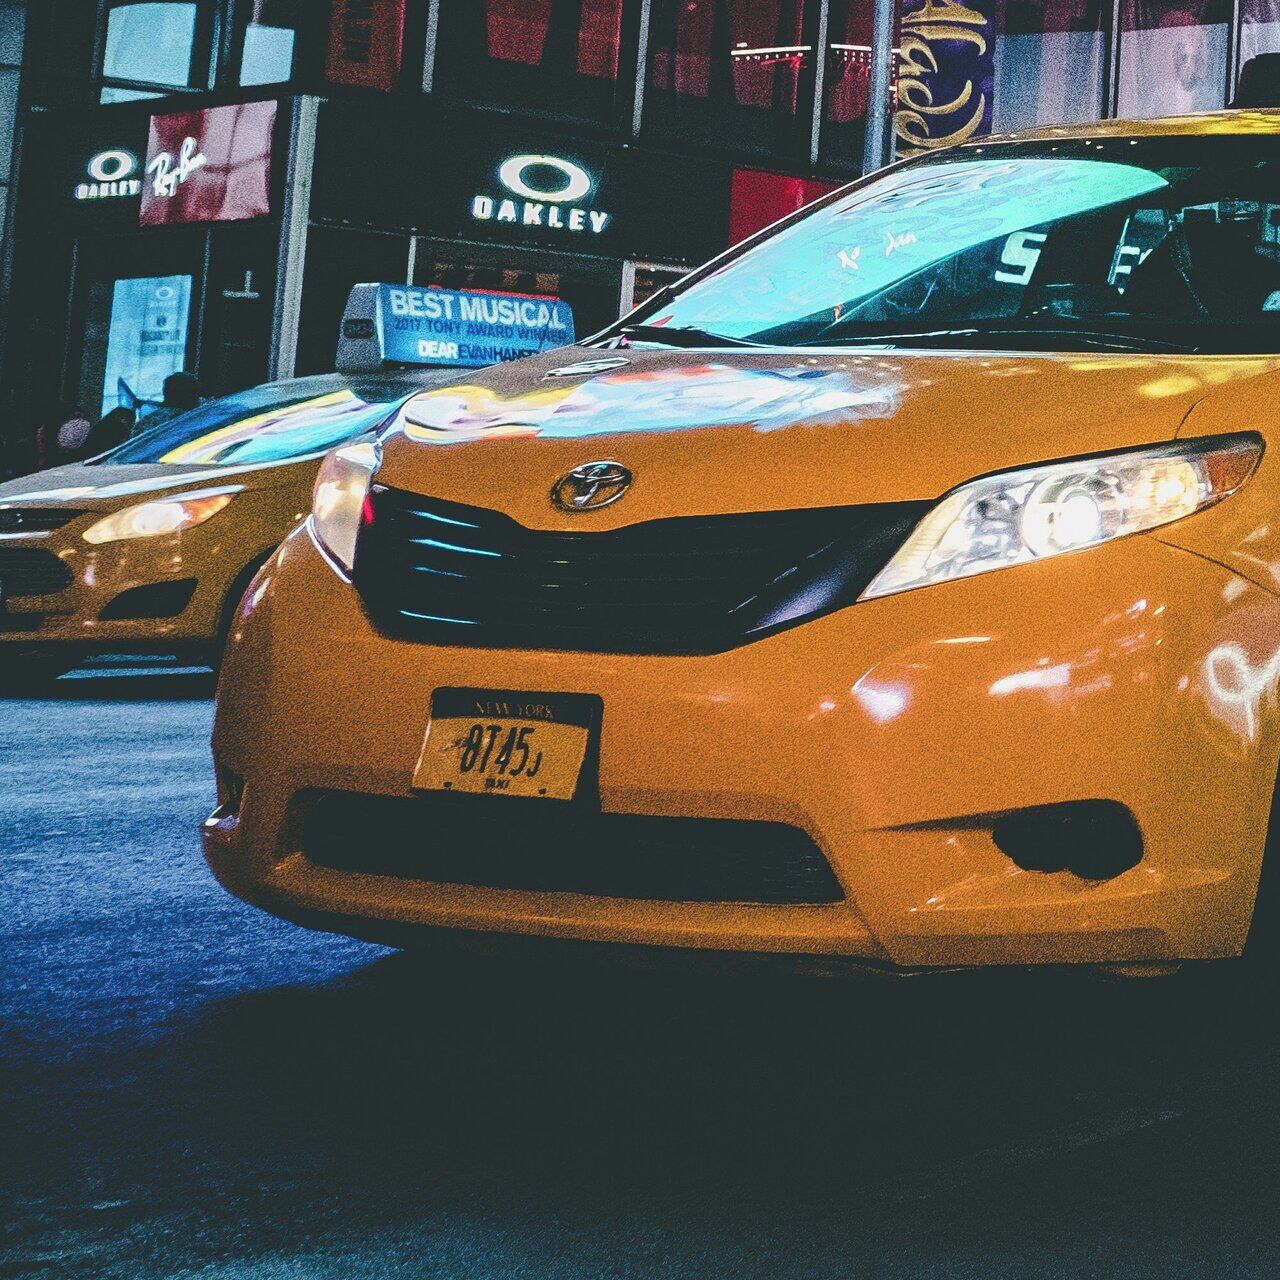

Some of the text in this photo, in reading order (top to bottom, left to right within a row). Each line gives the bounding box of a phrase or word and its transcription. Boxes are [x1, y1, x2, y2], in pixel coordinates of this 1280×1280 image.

[473, 195, 608, 233] OAKLEY
[390, 290, 567, 329] BEST MUSICAL
[467, 323, 514, 338] AWARD
[418, 339, 458, 360] DEAR
